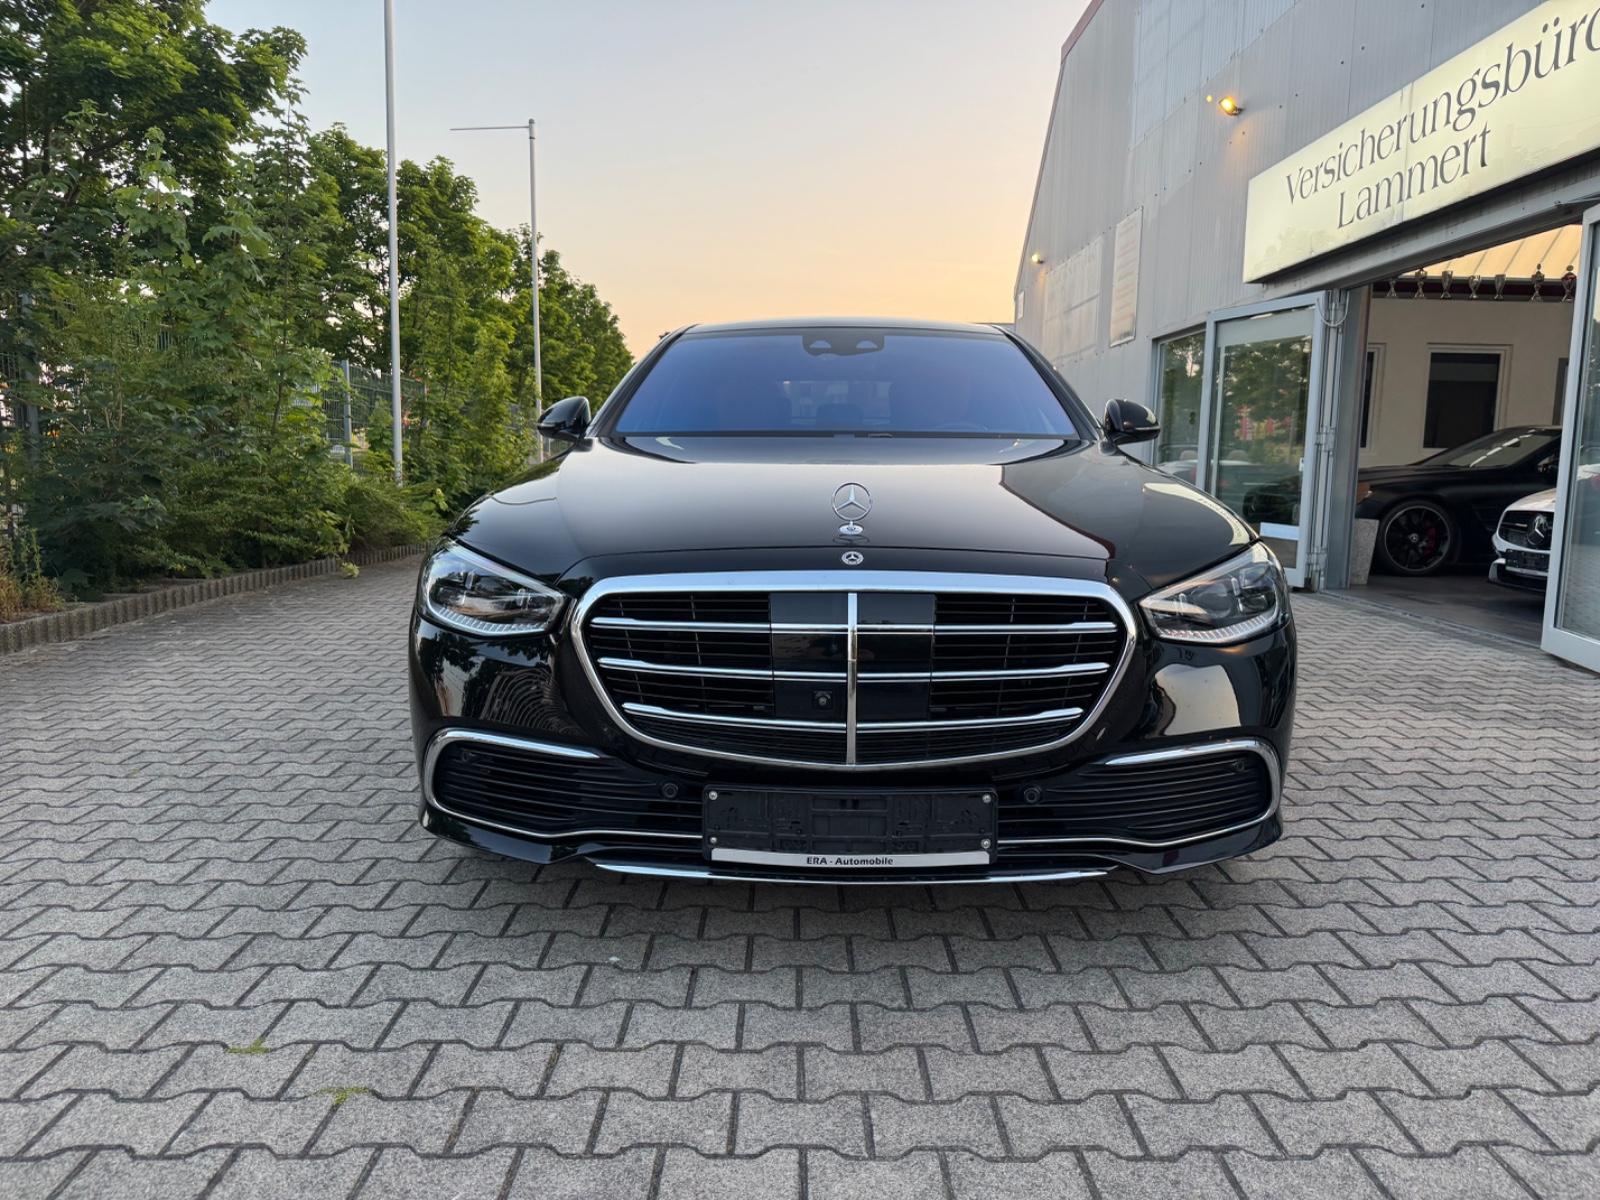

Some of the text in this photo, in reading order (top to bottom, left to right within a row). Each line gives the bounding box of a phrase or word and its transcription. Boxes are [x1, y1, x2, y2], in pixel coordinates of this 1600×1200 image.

[1338, 121, 1491, 229] Lammert
[806, 857, 828, 865] ERA
[835, 857, 894, 866] Automobile
